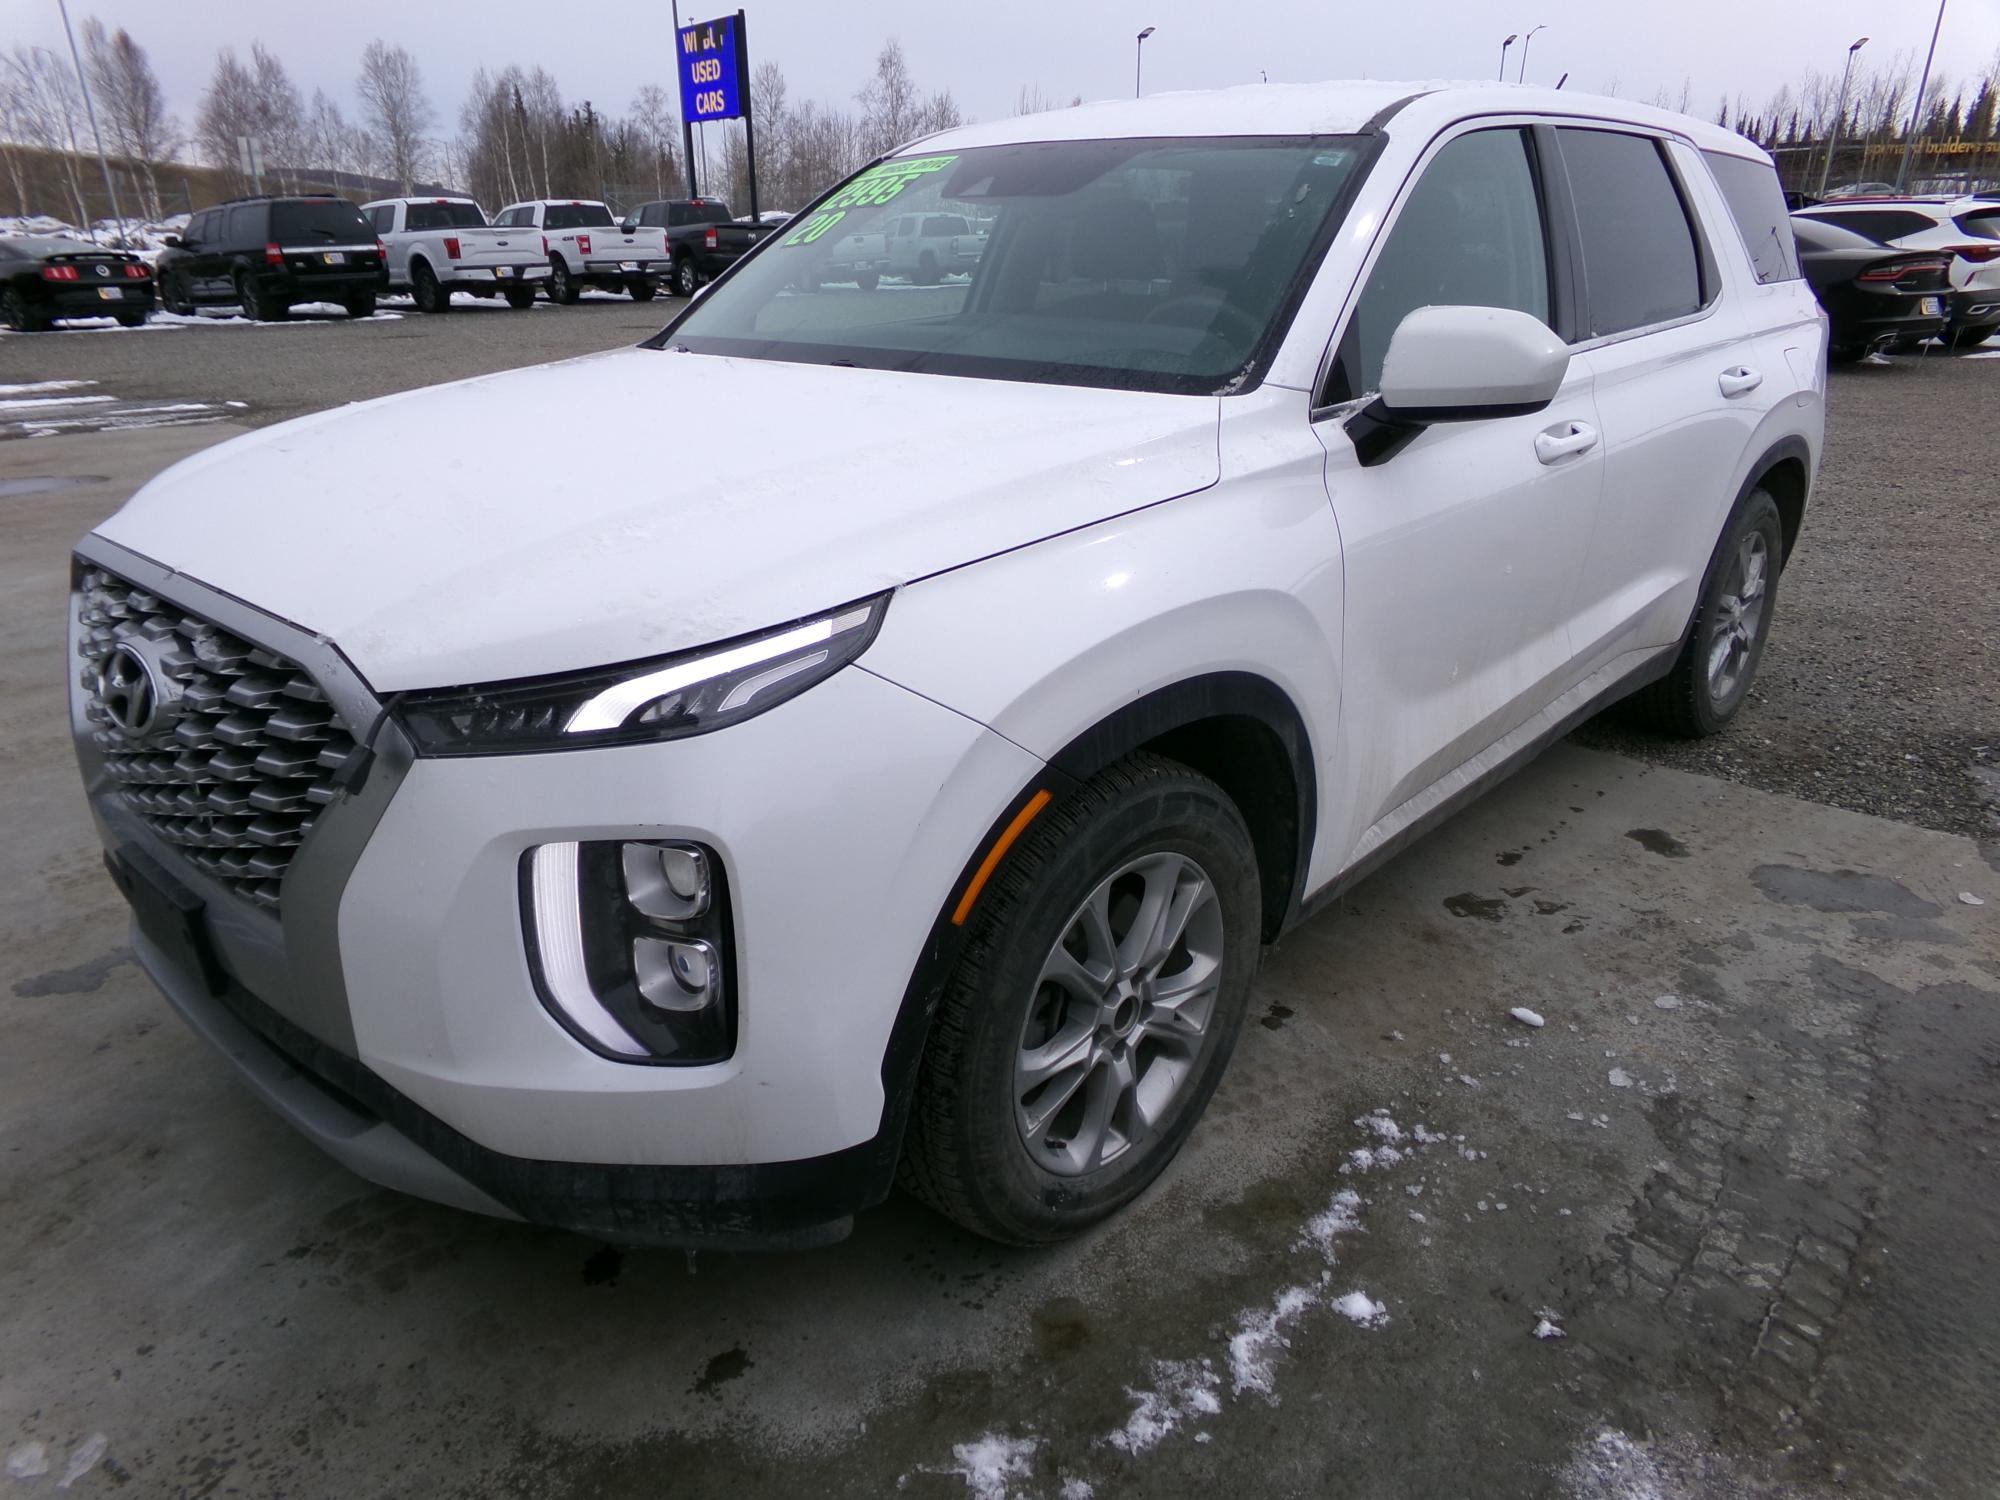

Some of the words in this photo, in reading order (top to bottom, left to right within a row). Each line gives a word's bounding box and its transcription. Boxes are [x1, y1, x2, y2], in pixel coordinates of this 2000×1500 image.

[691, 58, 721, 84] USED
[696, 90, 725, 114] CARS
[785, 211, 846, 246] 20
